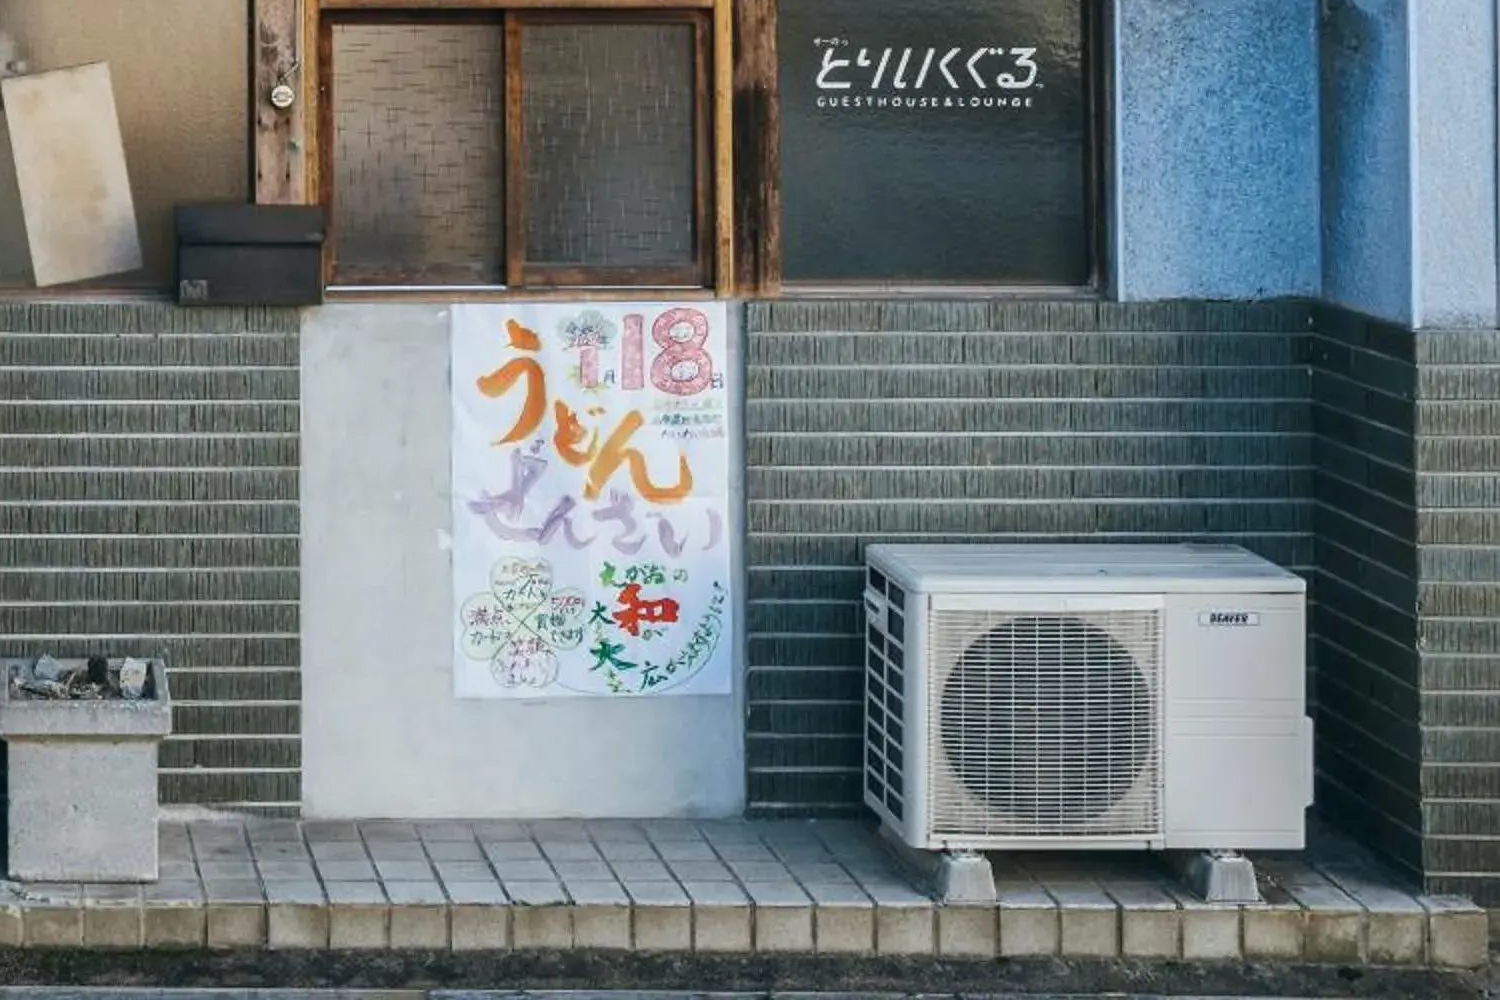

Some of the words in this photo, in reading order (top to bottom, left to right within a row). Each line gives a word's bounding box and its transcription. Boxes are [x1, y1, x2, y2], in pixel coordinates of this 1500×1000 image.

[815, 47, 1038, 89] とりいくぐる
[476, 318, 694, 505] うどん
